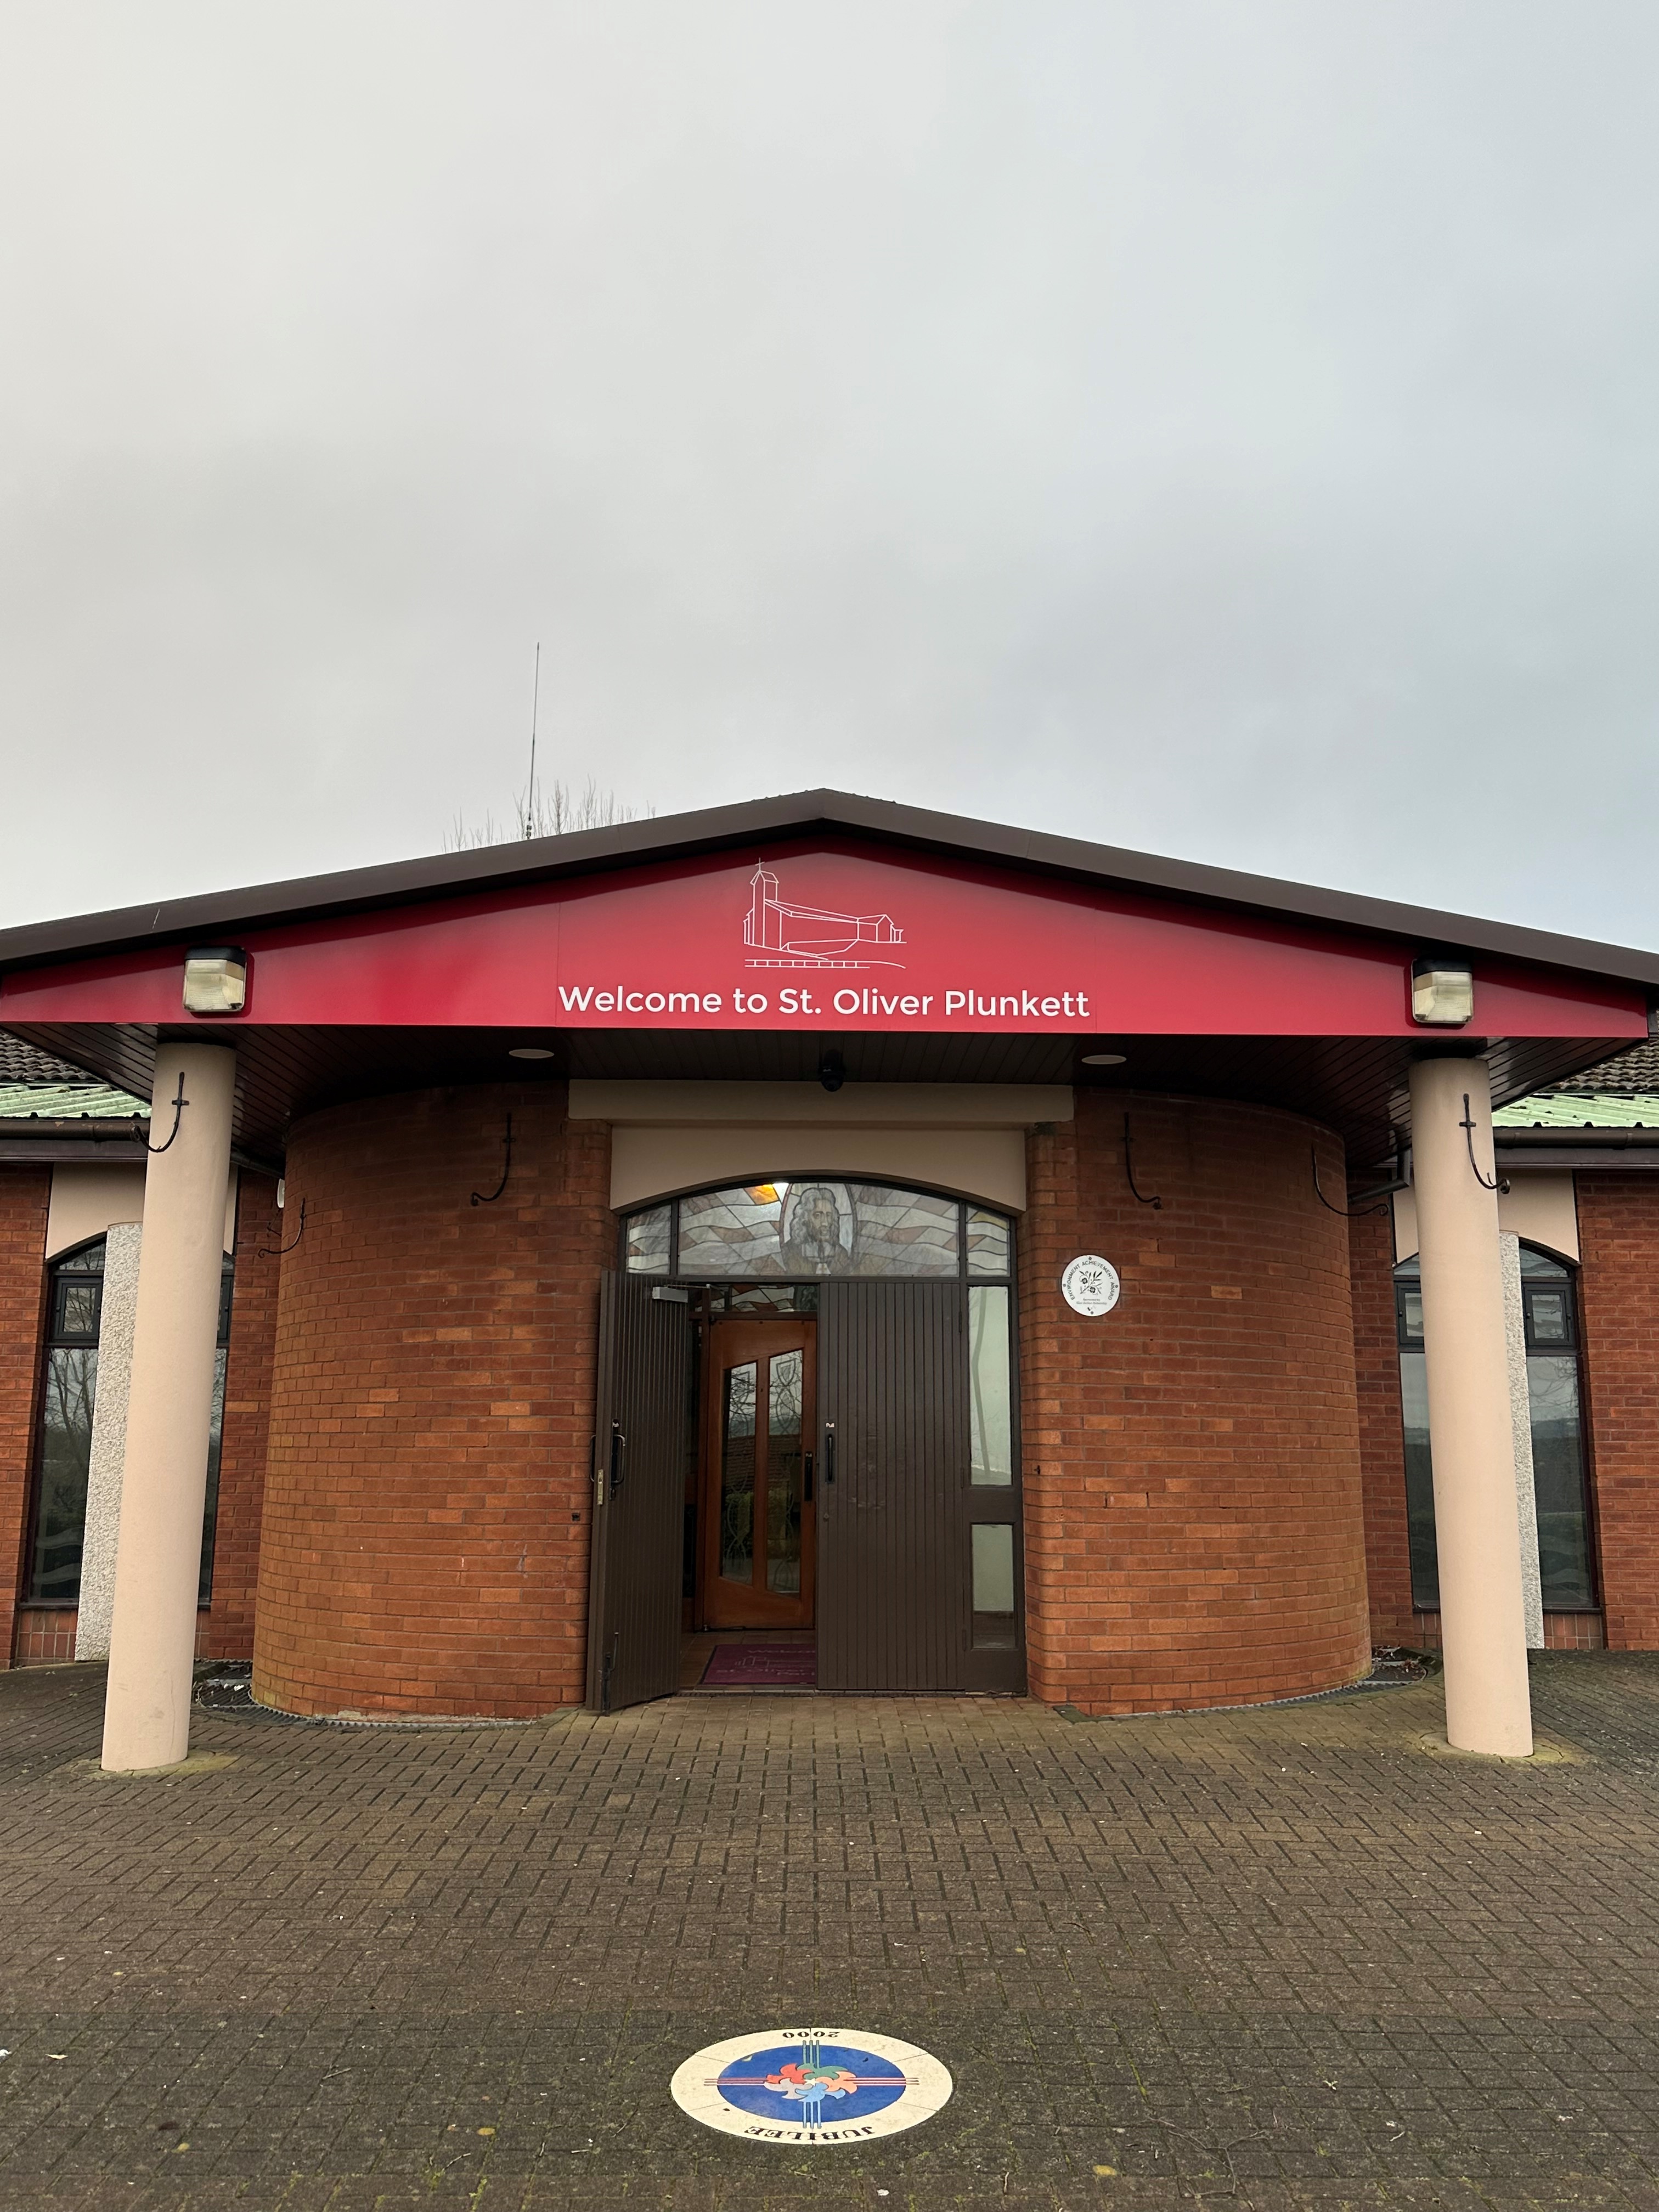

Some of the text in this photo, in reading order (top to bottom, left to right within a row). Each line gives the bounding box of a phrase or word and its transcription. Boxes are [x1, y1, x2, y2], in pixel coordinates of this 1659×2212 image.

[558, 985, 1090, 1017] Welcome to St. Oliver Plunkett
[1066, 1263, 1080, 1300] ENVIRONMENT
[1082, 1261, 1114, 1279] ACHIEVEMENT
[743, 2126, 875, 2141] JUBILEE
